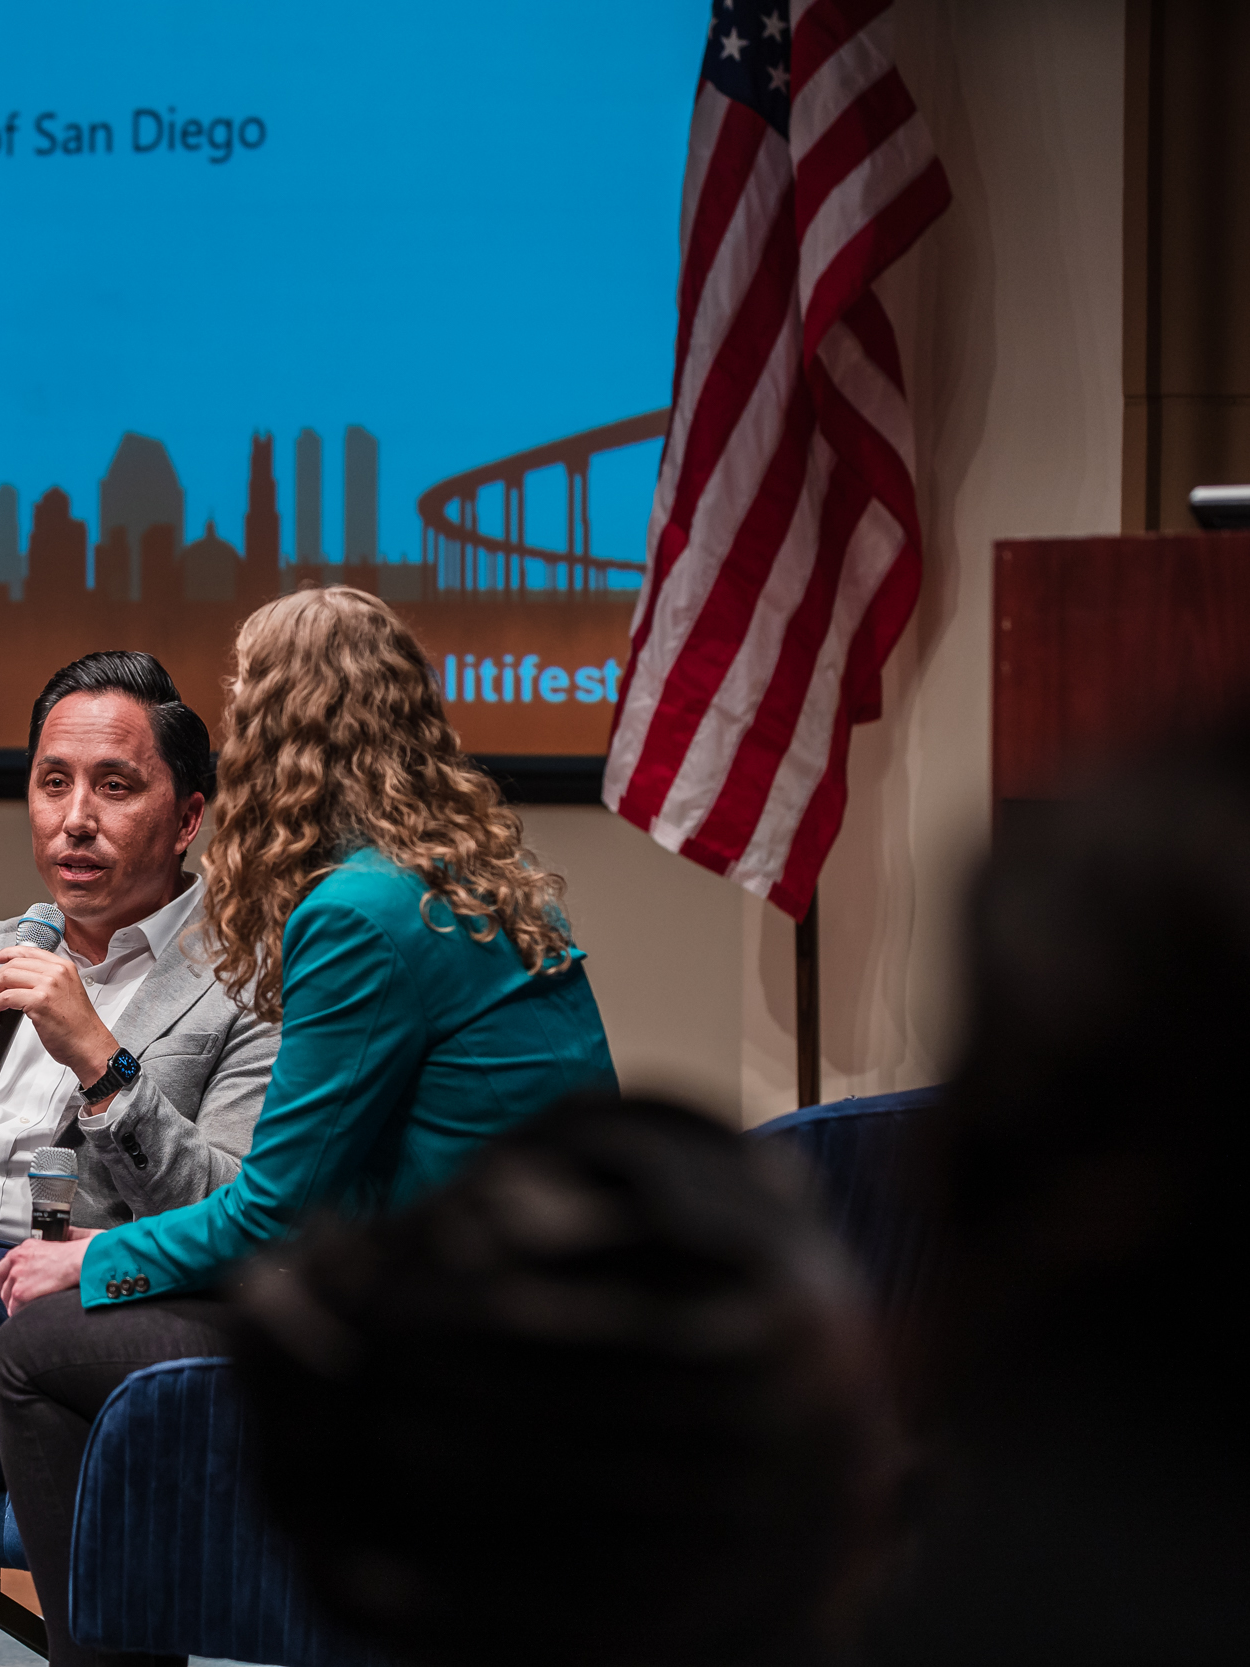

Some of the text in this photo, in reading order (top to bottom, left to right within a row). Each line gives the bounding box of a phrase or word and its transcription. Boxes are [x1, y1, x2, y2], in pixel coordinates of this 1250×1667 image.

[34, 112, 112, 156] San
[131, 106, 266, 164] Diego
[430, 654, 622, 702] litifest
